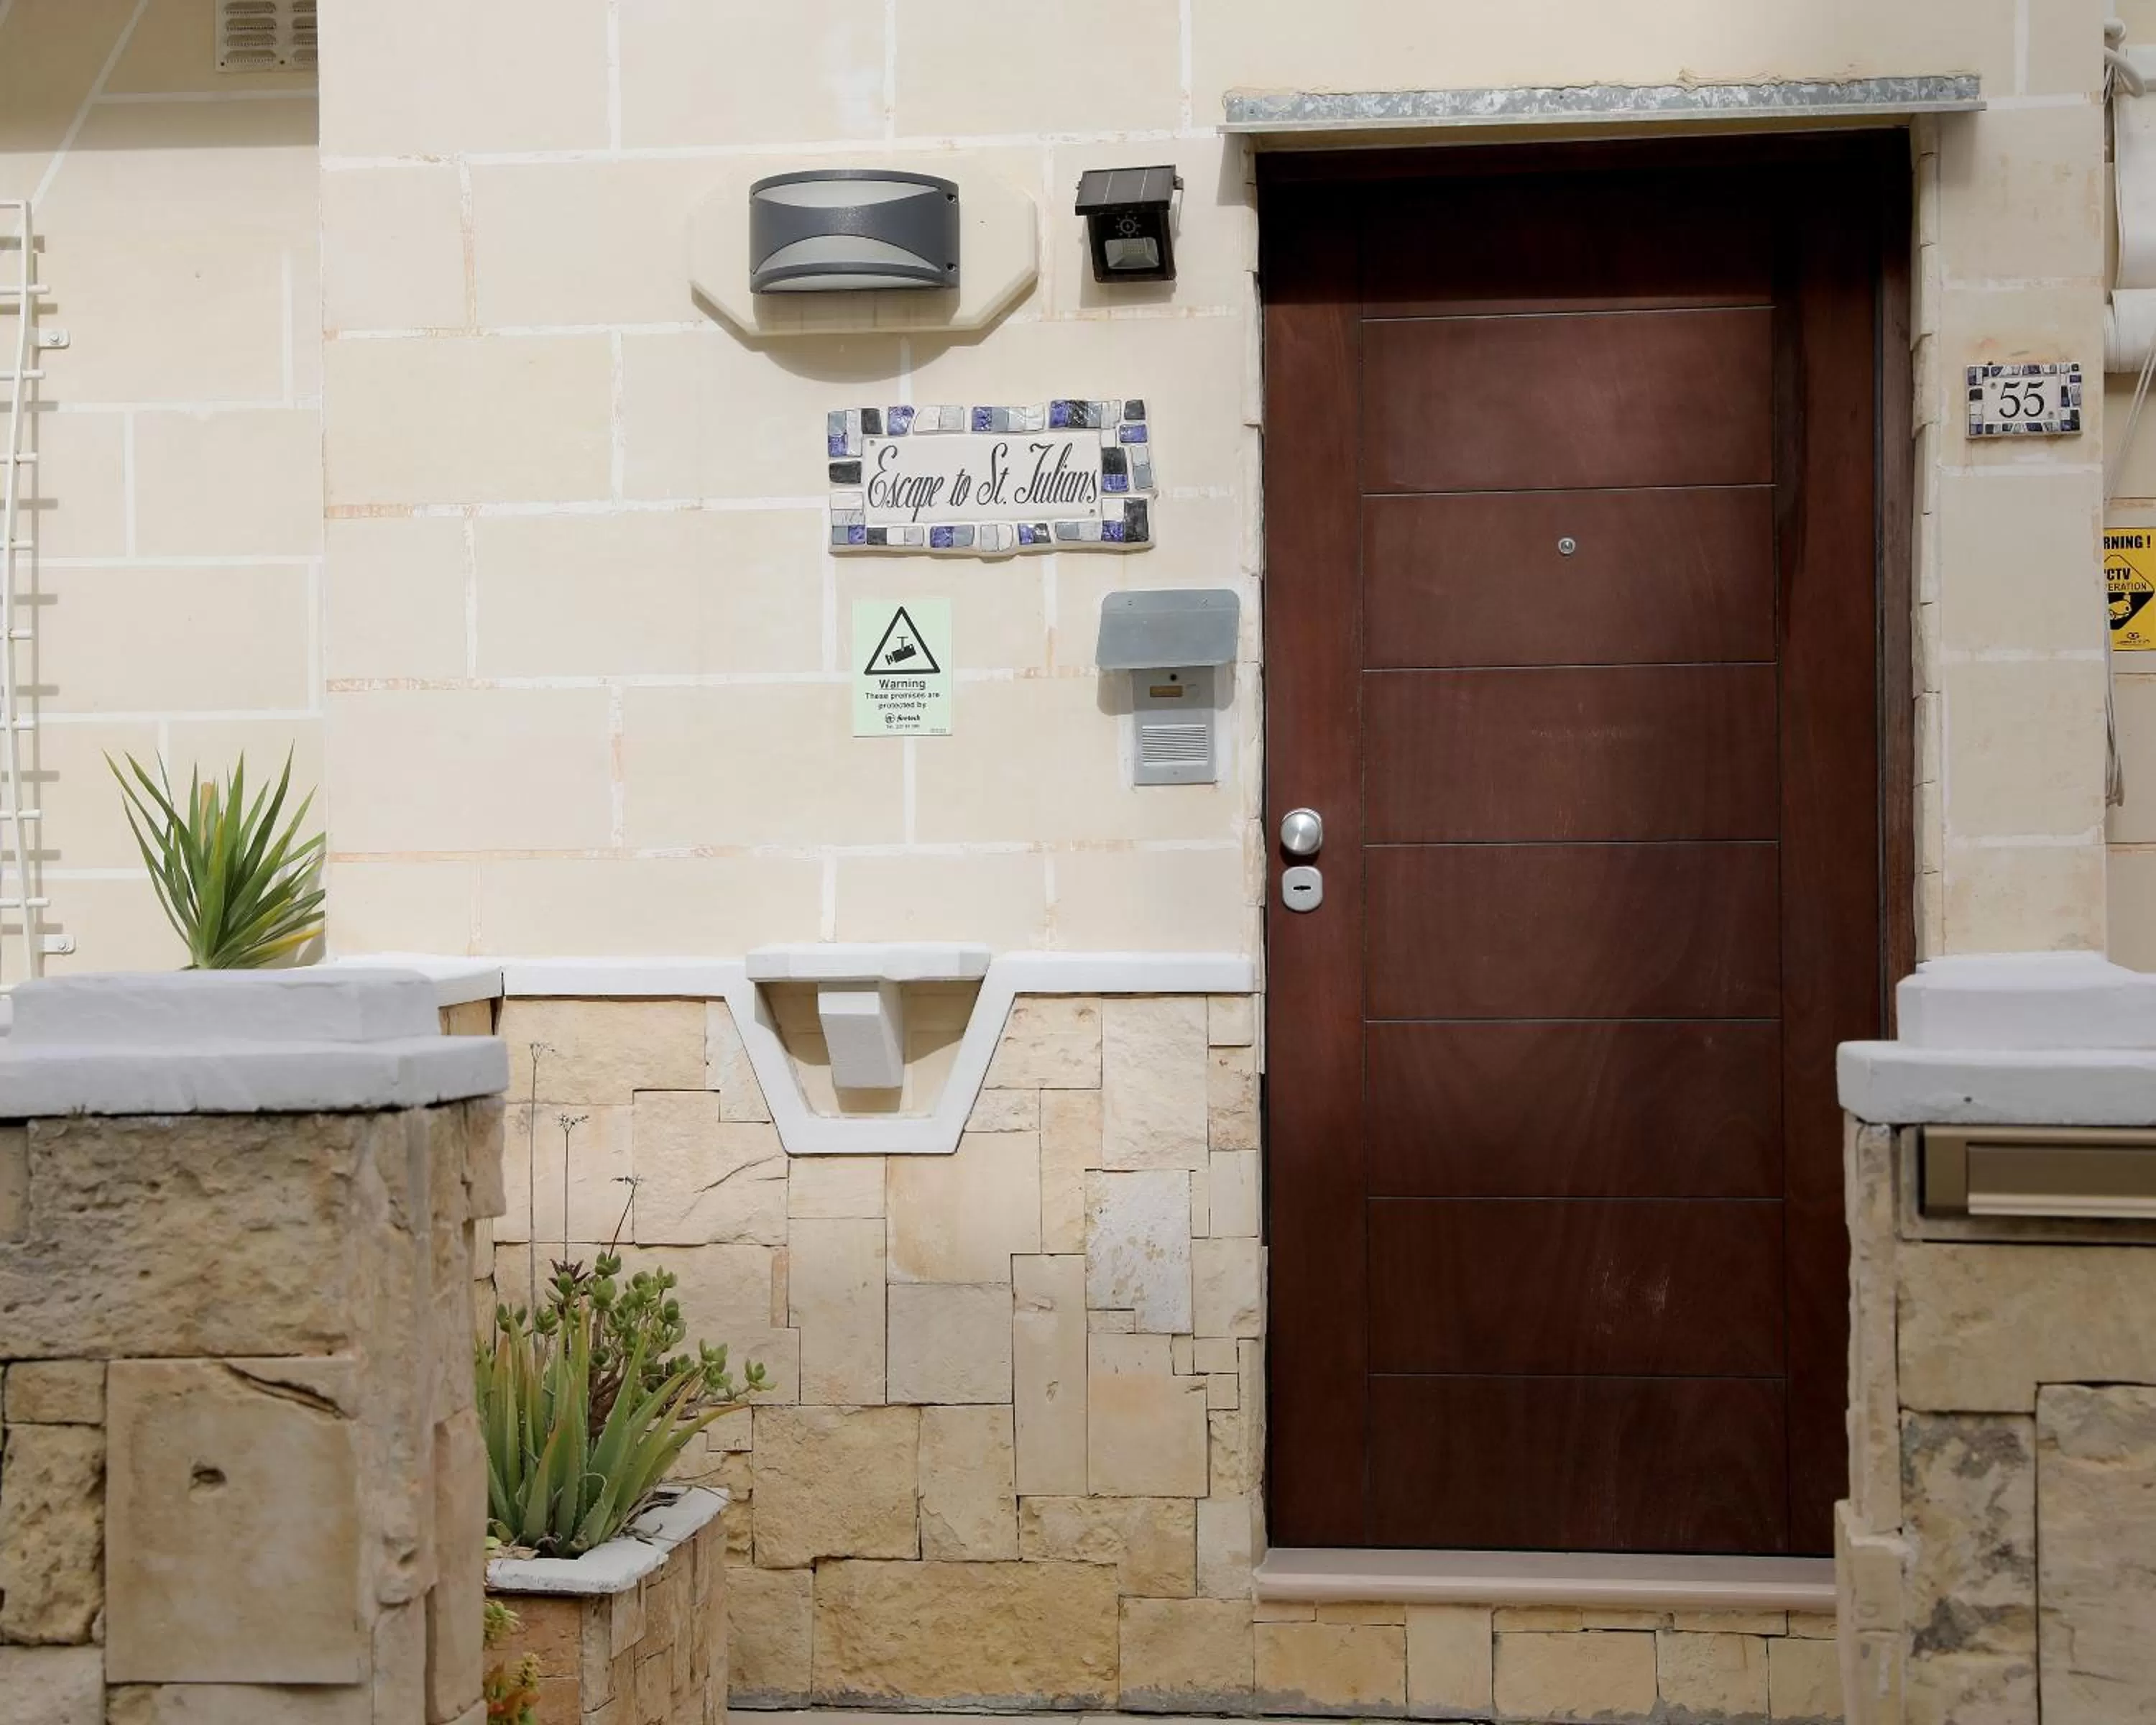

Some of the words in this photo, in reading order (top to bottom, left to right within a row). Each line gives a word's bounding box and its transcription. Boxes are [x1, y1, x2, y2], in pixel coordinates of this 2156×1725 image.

[1999, 381, 2045, 418] 55
[867, 445, 945, 523] Escape
[946, 468, 971, 507] to
[1013, 443, 1098, 504] Julians
[2104, 535, 2143, 550] RNING
[2104, 568, 2131, 581] CTV
[2106, 582, 2147, 592] ERATION
[879, 679, 926, 691] Warning
[916, 701, 927, 709] by
